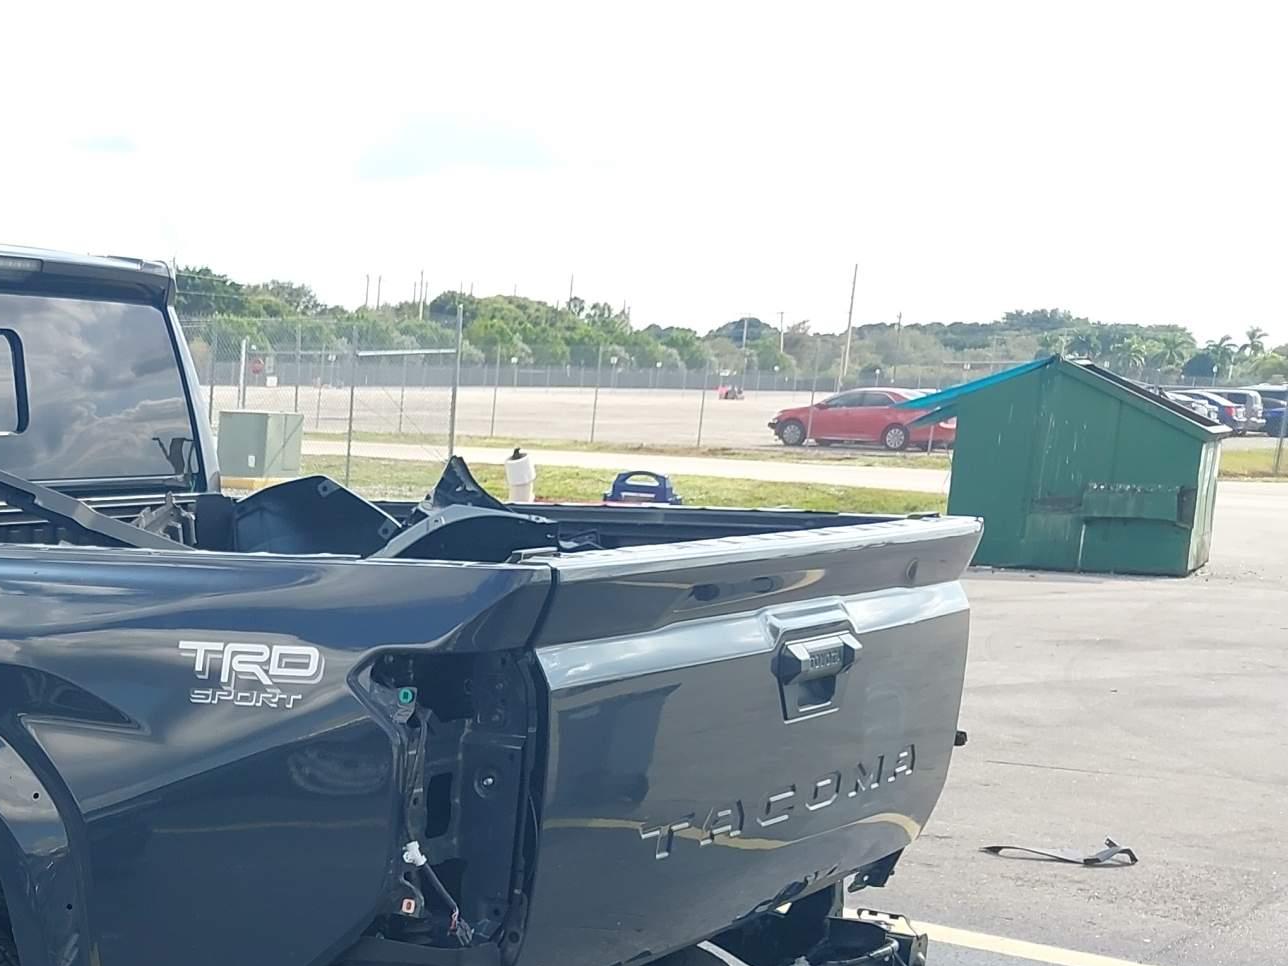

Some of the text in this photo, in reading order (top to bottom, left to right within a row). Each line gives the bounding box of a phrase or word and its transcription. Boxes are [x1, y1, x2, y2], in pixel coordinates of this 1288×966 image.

[178, 640, 324, 687] TRD
[189, 687, 302, 709] SPORT
[640, 744, 916, 860] TACOMA
